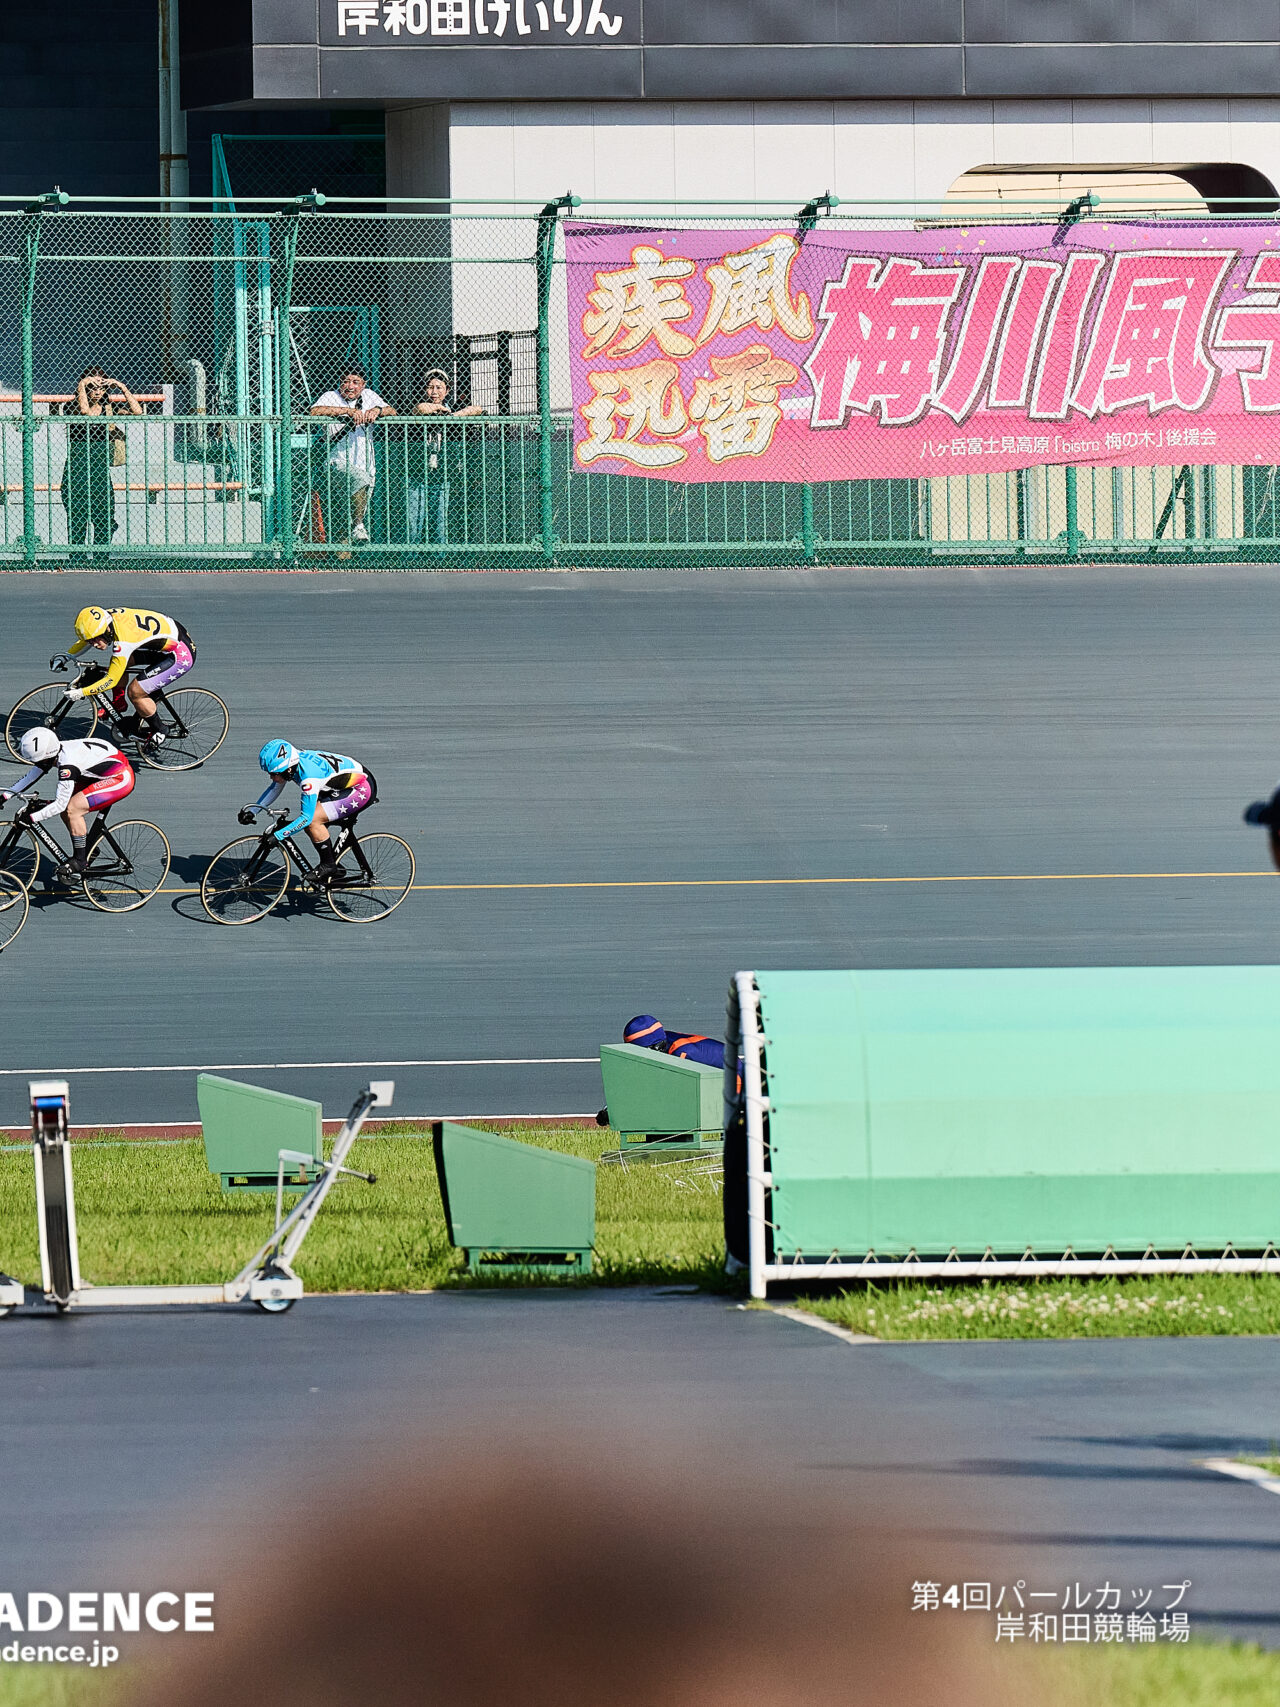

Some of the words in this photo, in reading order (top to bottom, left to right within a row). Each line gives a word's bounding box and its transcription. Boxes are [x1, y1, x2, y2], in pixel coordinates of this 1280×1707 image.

[337, 0, 623, 37] 岸和田けいりん
[1104, 427, 1217, 450] 梅の木」後援会
[89, 608, 101, 620] 5
[135, 614, 161, 636] 5
[97, 692, 122, 722] DGESTONE
[32, 736, 39, 752] 1
[277, 744, 288, 759] 4
[317, 752, 344, 774] 4
